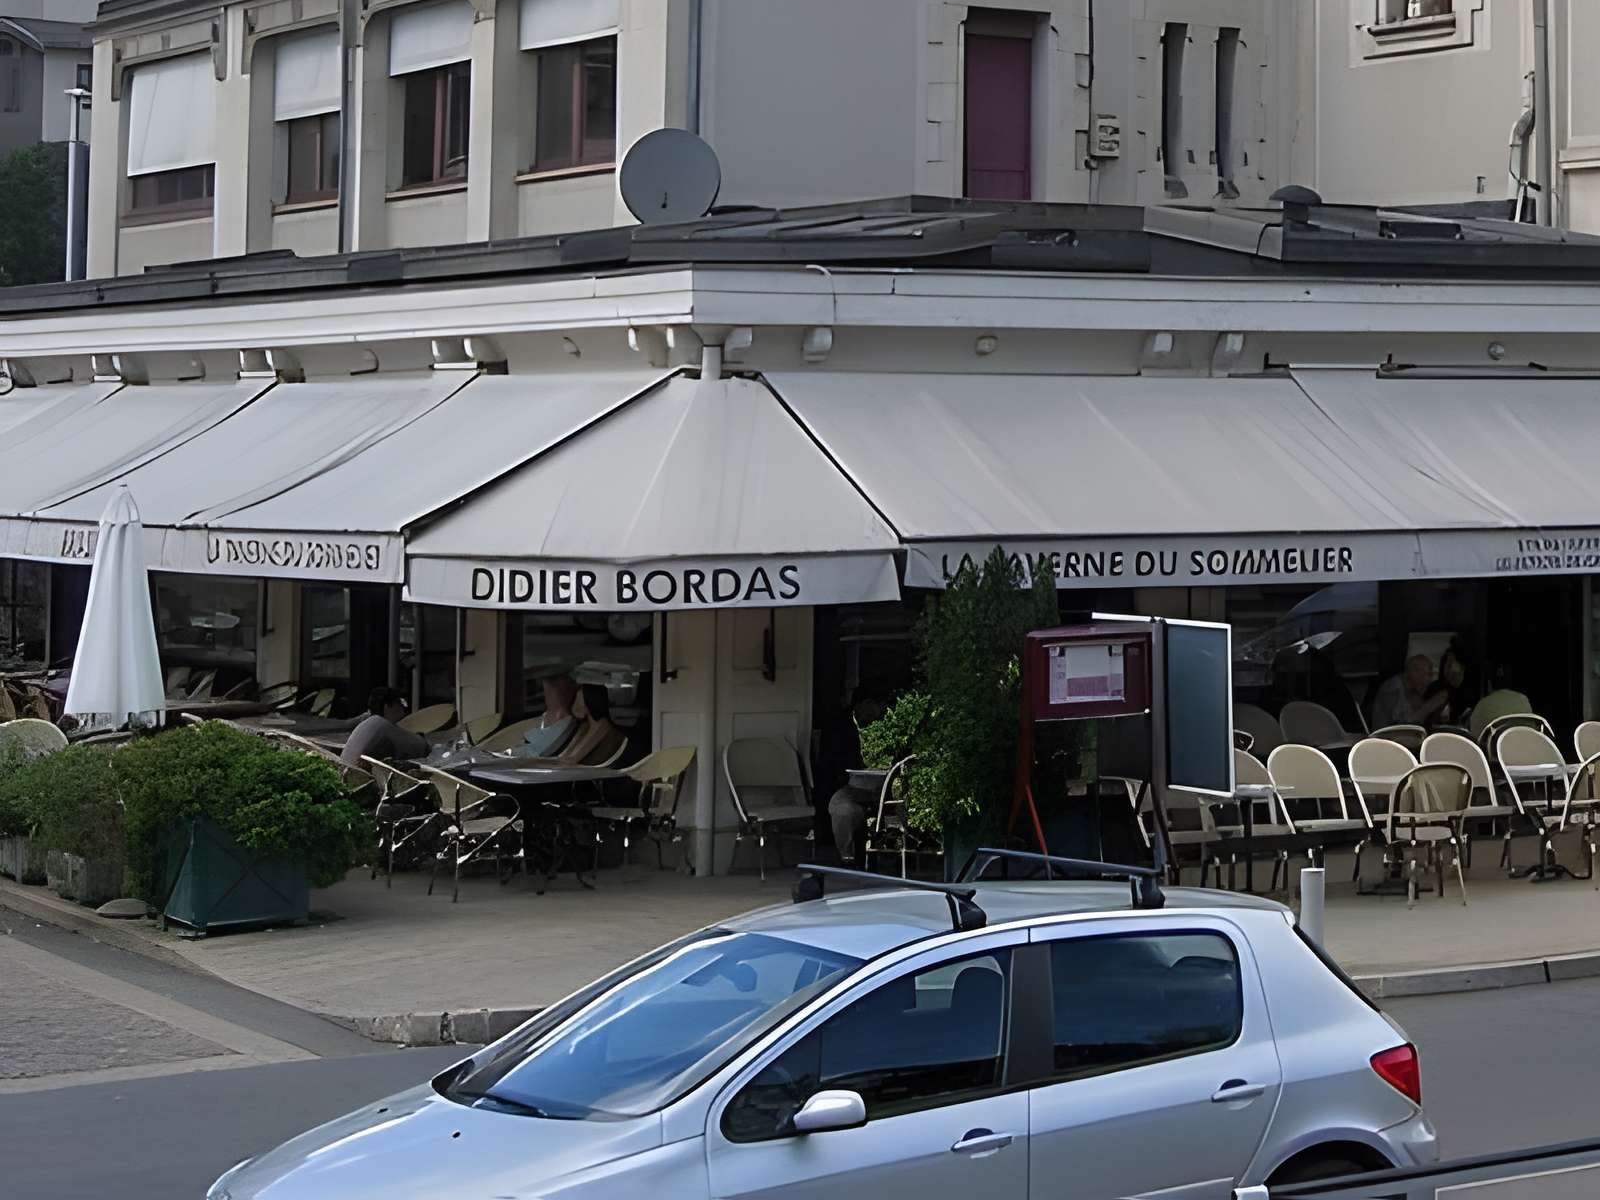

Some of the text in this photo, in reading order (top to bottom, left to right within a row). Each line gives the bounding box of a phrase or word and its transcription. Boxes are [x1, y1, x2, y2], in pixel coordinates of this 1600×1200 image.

[986, 550, 1124, 578] AVERNE
[1135, 550, 1178, 577] DU
[471, 564, 801, 604] DIDIER BORDAS
